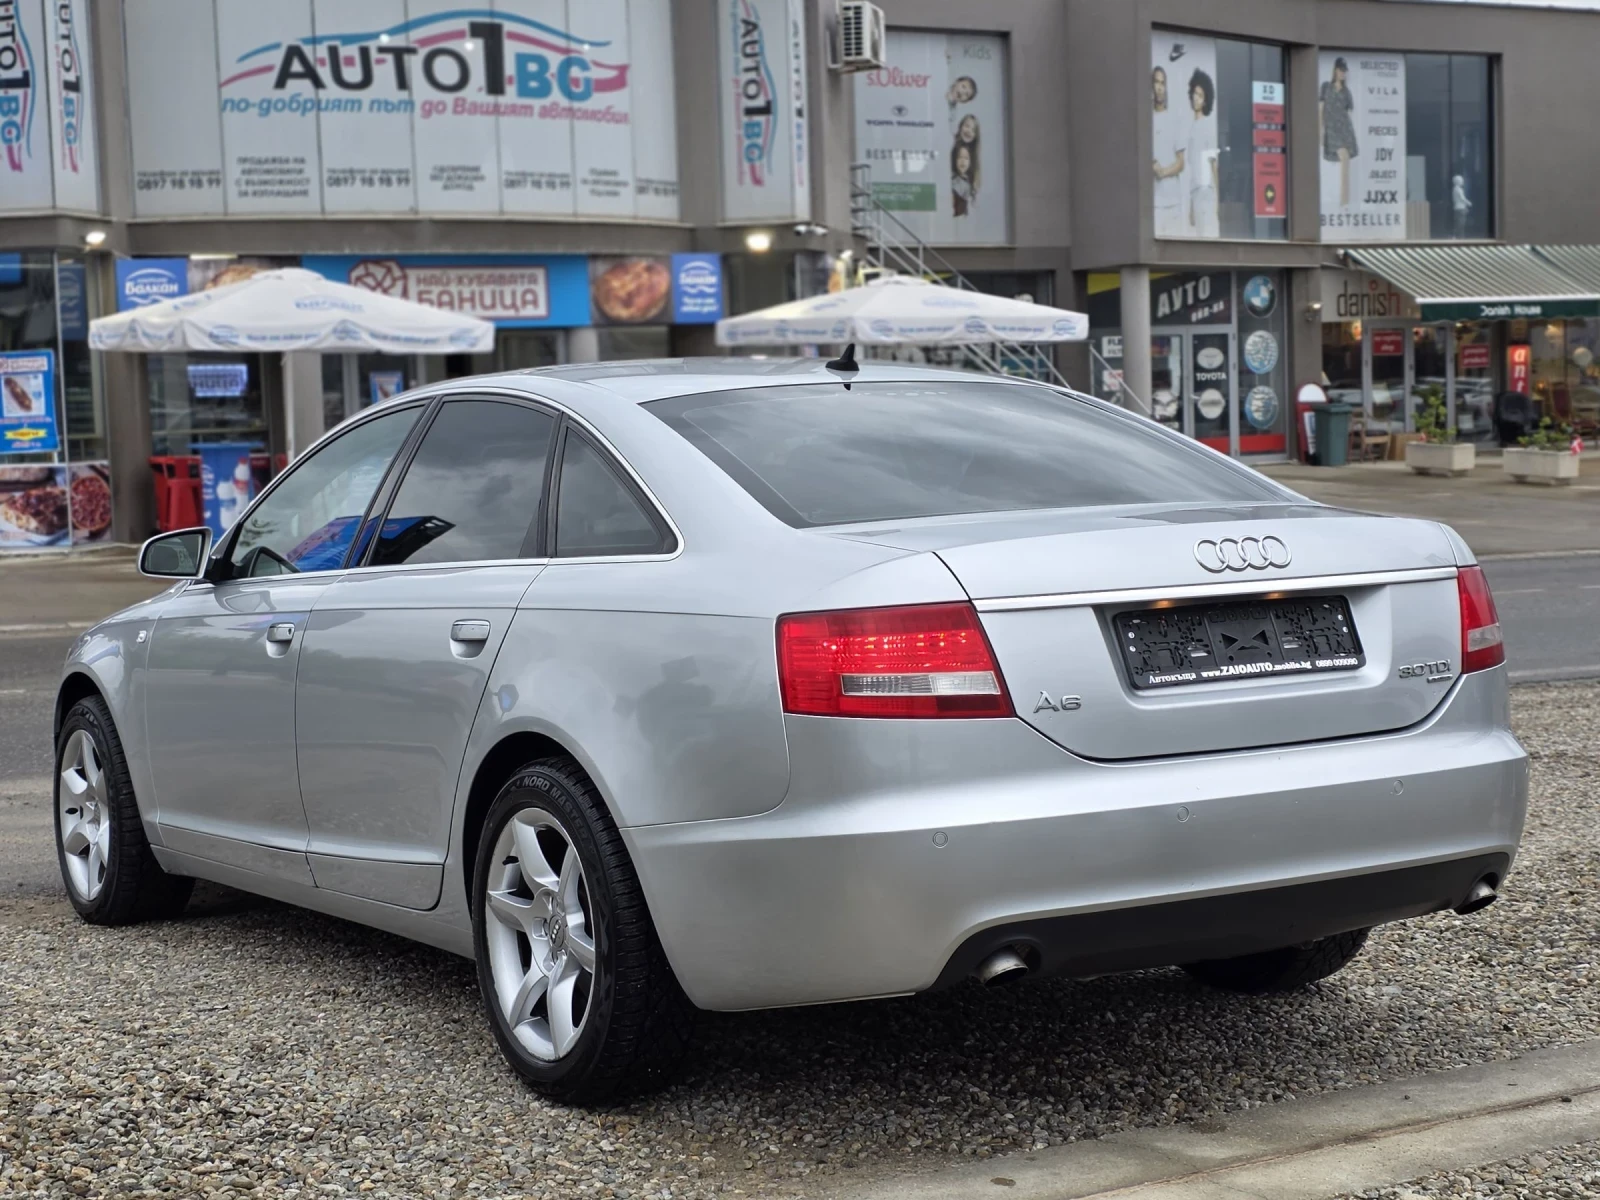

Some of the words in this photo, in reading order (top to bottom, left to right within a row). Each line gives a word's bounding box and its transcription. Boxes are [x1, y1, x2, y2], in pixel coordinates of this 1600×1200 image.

[963, 44, 992, 61] Kids
[1360, 60, 1399, 71] SELECTED
[1368, 86, 1399, 96] VILA
[221, 92, 362, 118] по-добрият
[369, 97, 415, 114] път
[420, 98, 447, 118] до
[1368, 126, 1398, 137] PIECES
[1375, 147, 1394, 161] JDY
[1363, 190, 1399, 205] JJXX
[1320, 214, 1401, 228] BESTSELLER
[125, 280, 179, 296] Балкан
[416, 288, 539, 316] БАНИЦА
[1337, 280, 1400, 317] danish
[1480, 304, 1511, 317] Danish
[1196, 372, 1227, 382] TOYOTA
[1033, 690, 1082, 714] A6
[523, 776, 551, 791] NORD
